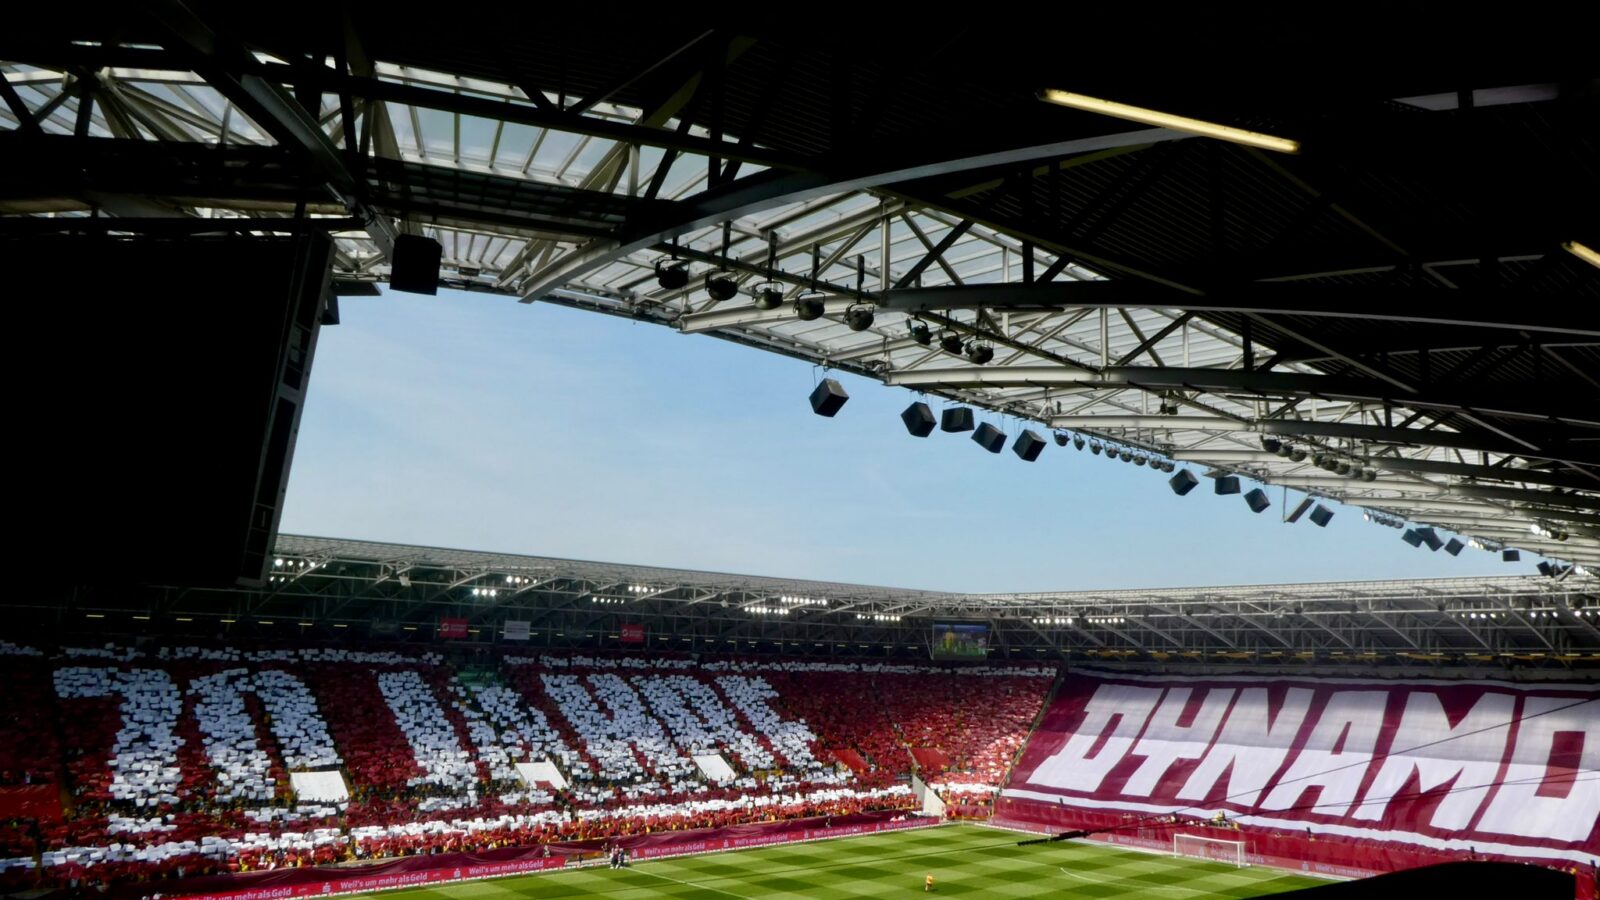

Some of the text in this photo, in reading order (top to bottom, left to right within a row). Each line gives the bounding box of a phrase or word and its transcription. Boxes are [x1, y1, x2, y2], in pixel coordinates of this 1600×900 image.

[1027, 683, 1600, 842] DYNAMO
[469, 866, 489, 875] Weil's
[501, 863, 518, 871] mehr
[518, 861, 528, 869] als
[528, 859, 544, 868] Geld
[340, 878, 364, 889] Weil's
[378, 877, 397, 885] mehr
[398, 875, 410, 883] als
[410, 873, 428, 882] Geld
[234, 892, 257, 900] mehr
[257, 889, 271, 899] als
[271, 887, 292, 897] Geld
